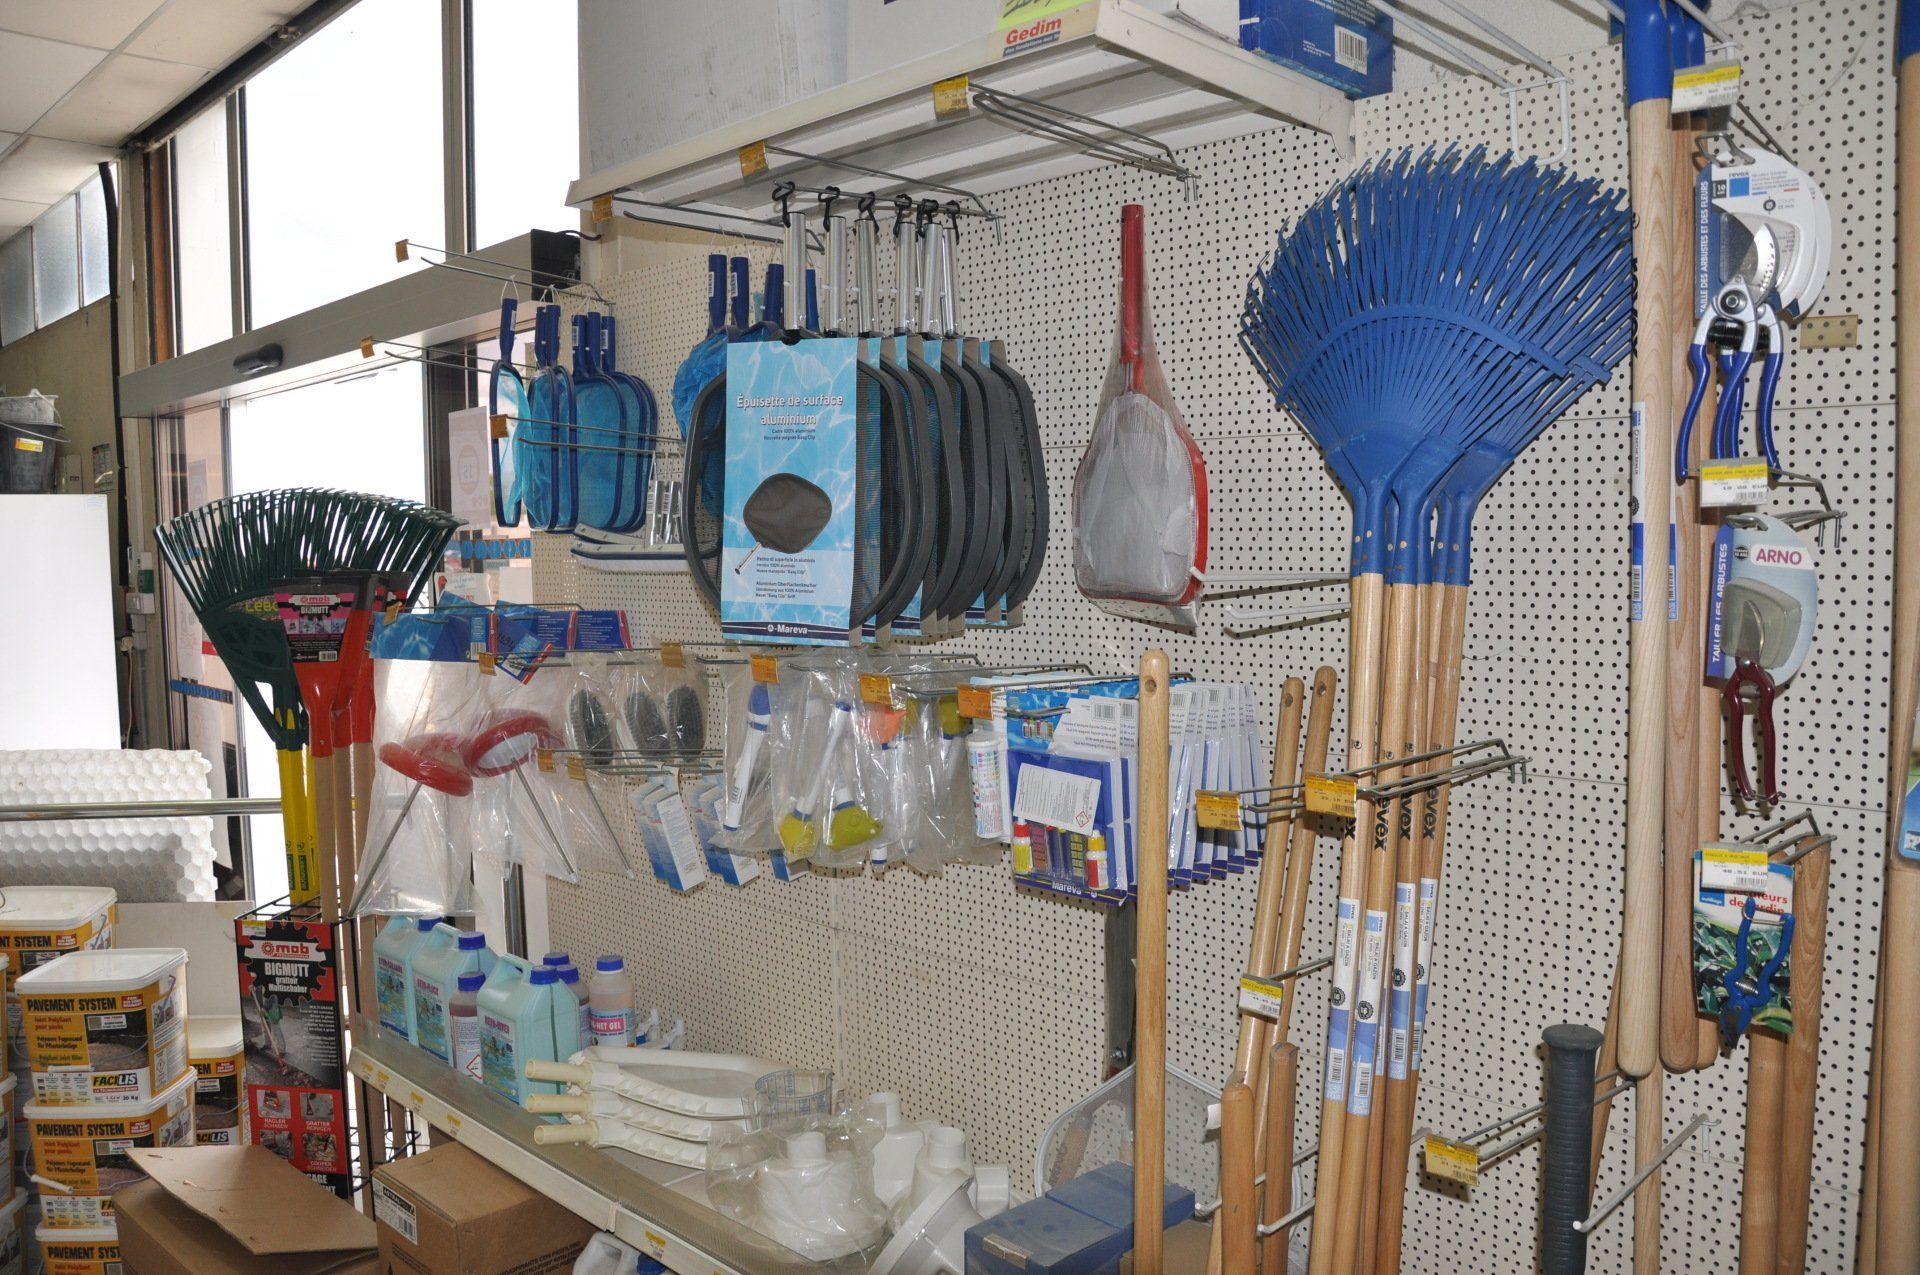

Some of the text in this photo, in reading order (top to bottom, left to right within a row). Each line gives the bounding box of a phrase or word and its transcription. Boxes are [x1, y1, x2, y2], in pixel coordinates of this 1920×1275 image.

[1006, 18, 1061, 44] Gedim
[1700, 181, 1709, 207] FLEURS
[1700, 208, 1708, 224] DES
[1700, 225, 1709, 234] ET
[1700, 234, 1709, 272] ARBUSTES
[1700, 274, 1708, 289] DES
[736, 392, 844, 411] Épuisette de surface
[760, 414, 817, 426] aluminium
[1755, 548, 1802, 565] ARNO
[1716, 543, 1728, 598] ARBUSTES
[777, 624, 808, 634] Mareva
[1051, 880, 1082, 896] Mareva
[14, 935, 51, 948] SYSTEM
[275, 943, 310, 955] mob
[264, 962, 310, 977] BIGMUTT
[268, 983, 308, 993] Multischaber
[275, 976, 298, 985] grattoir
[27, 998, 75, 1012] PAVEMENT
[79, 997, 117, 1011] SYSTEM
[609, 1022, 622, 1030] GEL
[93, 1072, 138, 1087] FACILIS
[36, 1123, 125, 1136] PAVEMENT SYSTEM
[48, 1246, 121, 1259] PAVEMENT SYST
